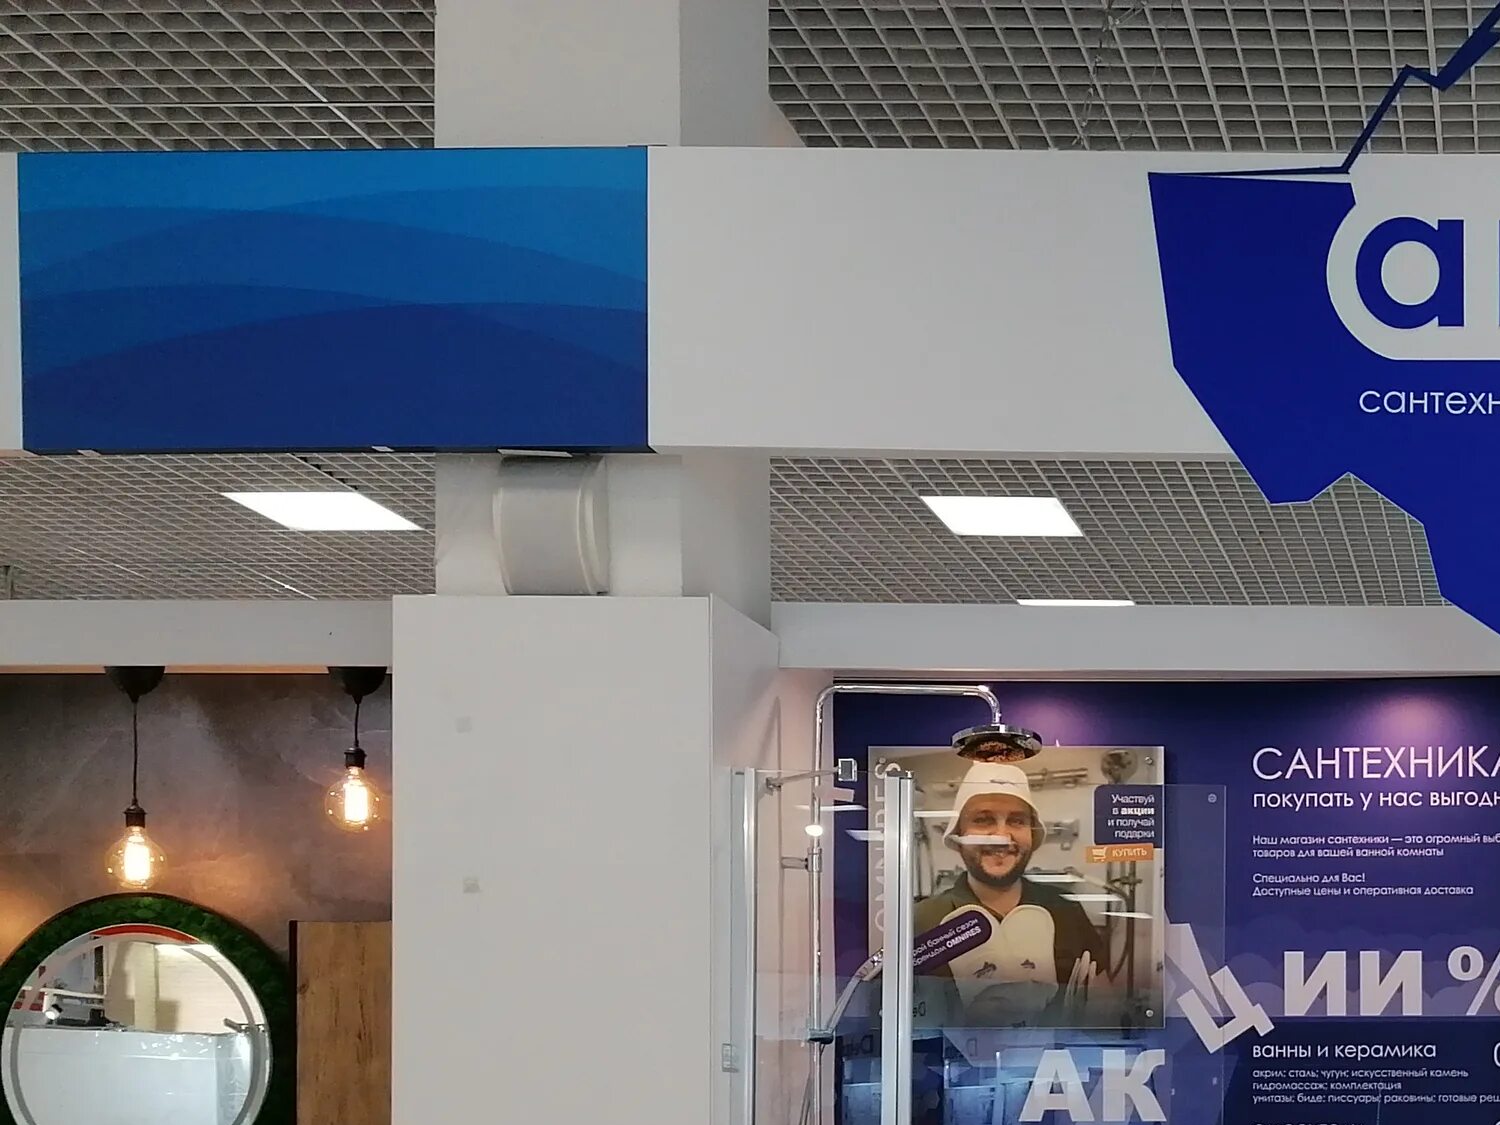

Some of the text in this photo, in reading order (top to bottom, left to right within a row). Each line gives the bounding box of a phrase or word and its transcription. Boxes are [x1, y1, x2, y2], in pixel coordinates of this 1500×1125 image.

[1111, 794, 1155, 806] Участвуй
[1253, 792, 1354, 812] покупать
[1359, 792, 1373, 812] у
[1379, 791, 1423, 807] нас
[1120, 807, 1155, 817] акции
[1107, 818, 1155, 829] и получай
[1114, 830, 1155, 840] подарки
[1334, 1044, 1437, 1062] керамика
